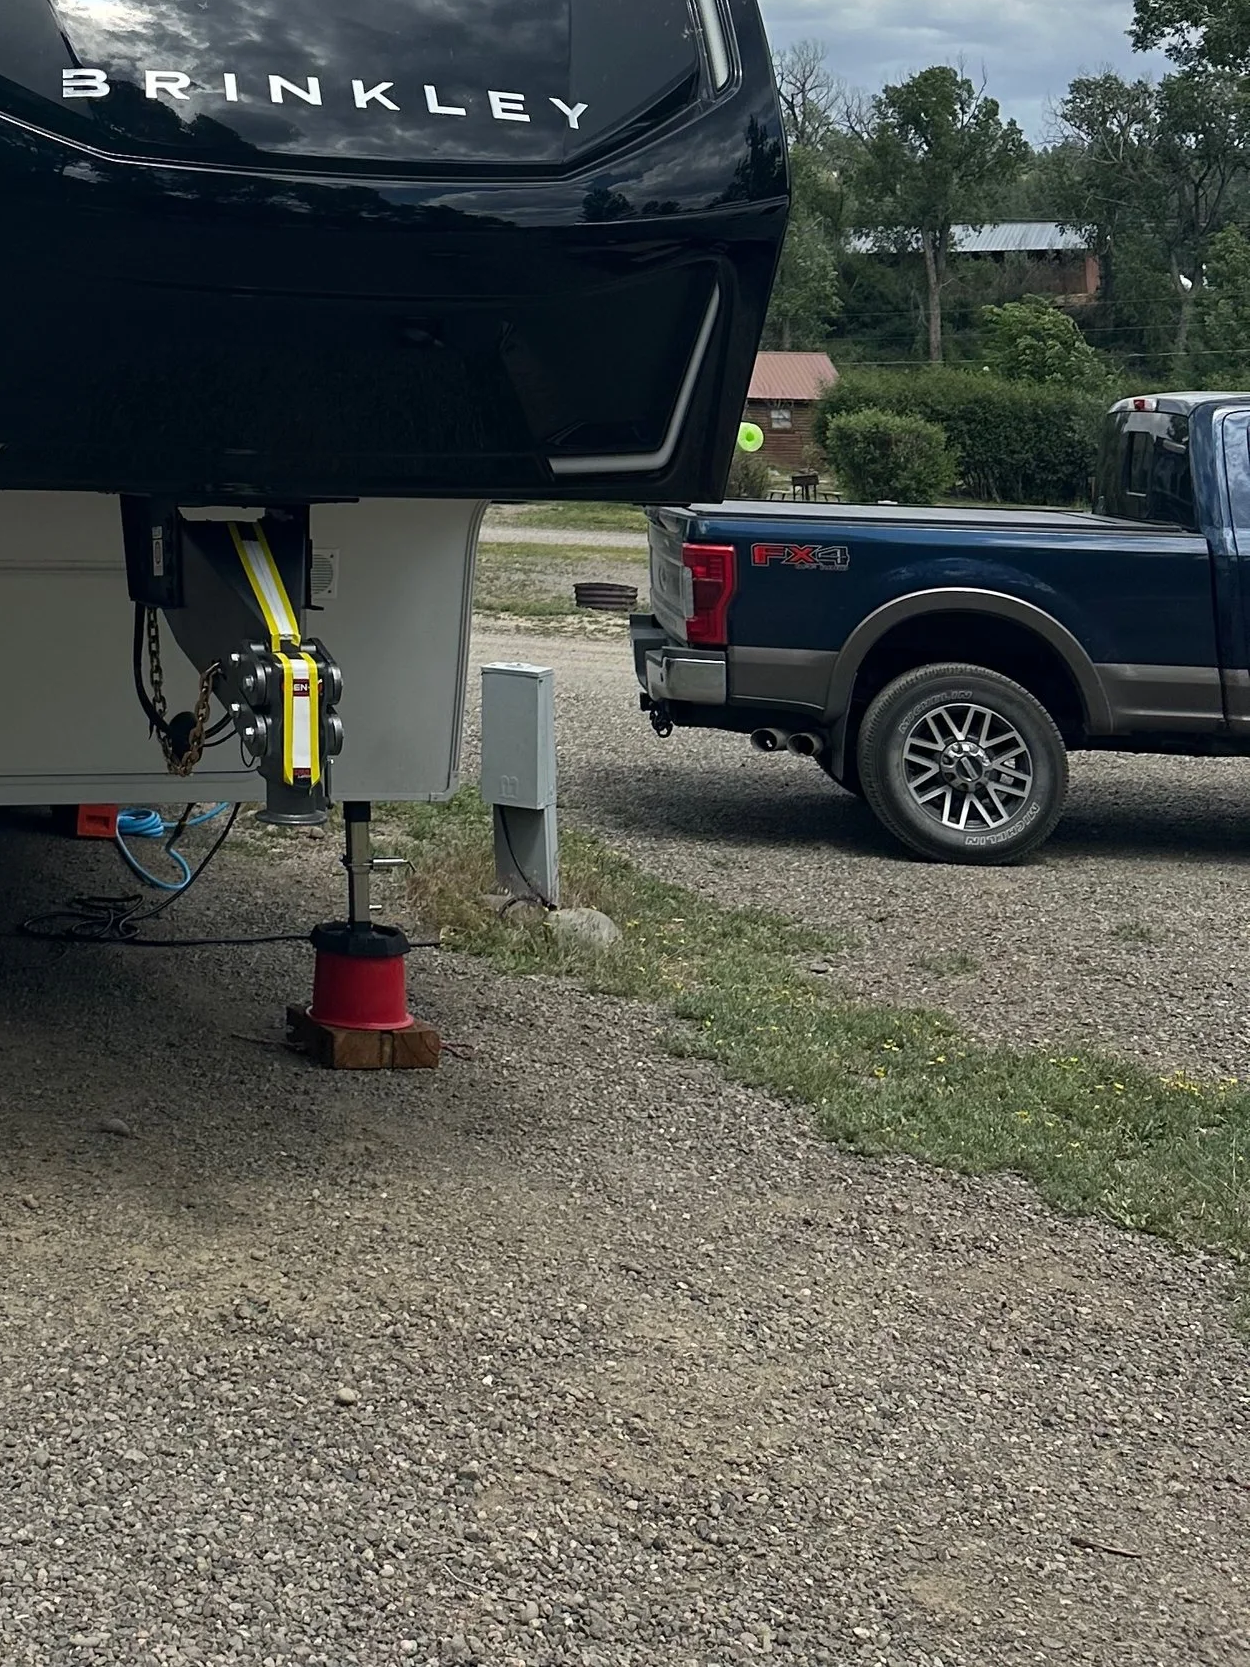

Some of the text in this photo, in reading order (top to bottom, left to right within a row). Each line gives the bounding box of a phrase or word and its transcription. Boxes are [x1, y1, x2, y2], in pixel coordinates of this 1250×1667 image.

[62, 68, 589, 130] BRINKLEY
[751, 542, 850, 567] FX4
[965, 801, 1041, 846] MICHELIN
